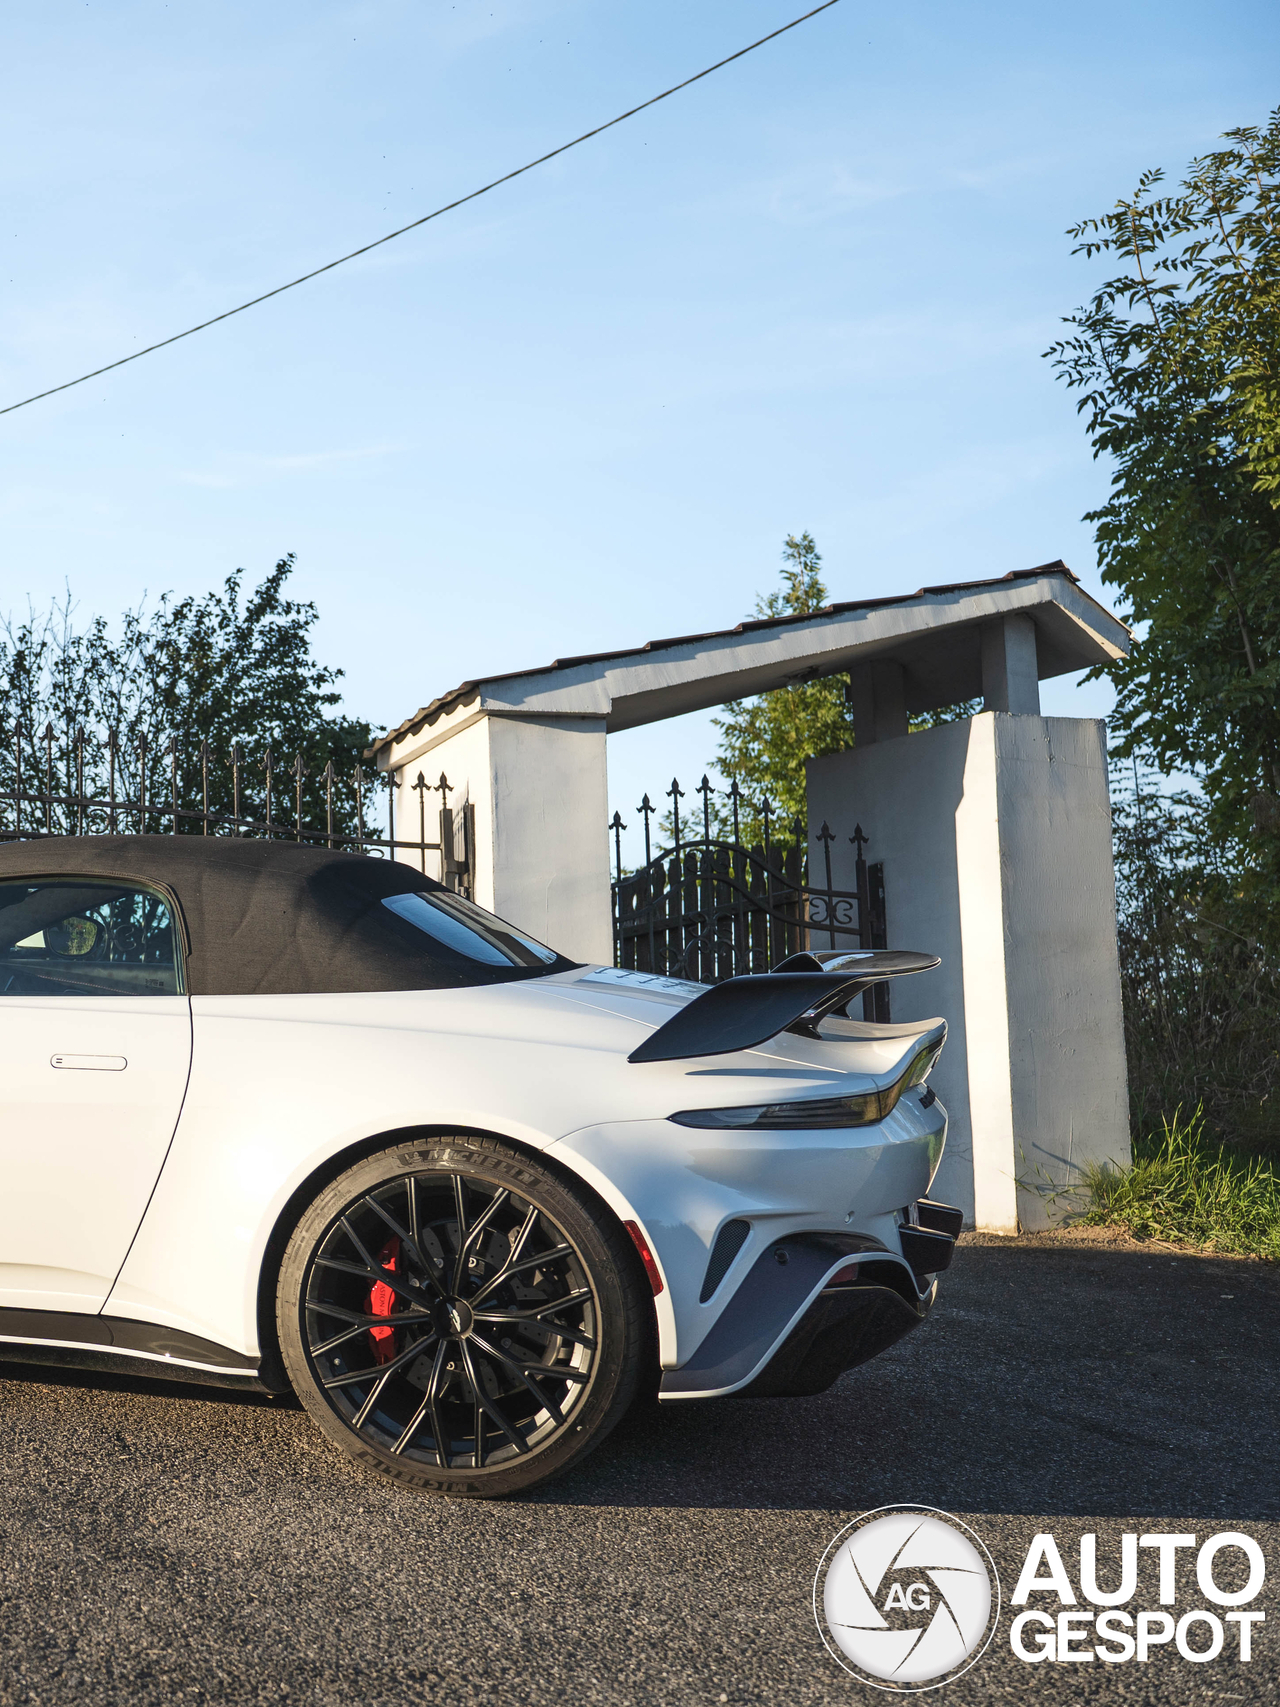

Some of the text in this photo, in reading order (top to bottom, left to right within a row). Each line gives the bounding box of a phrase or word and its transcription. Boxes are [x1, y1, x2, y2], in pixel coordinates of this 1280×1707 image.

[427, 1150, 535, 1184] MICHELIN
[545, 1188, 569, 1209] PILOT
[362, 1454, 468, 1492] MICHELIN
